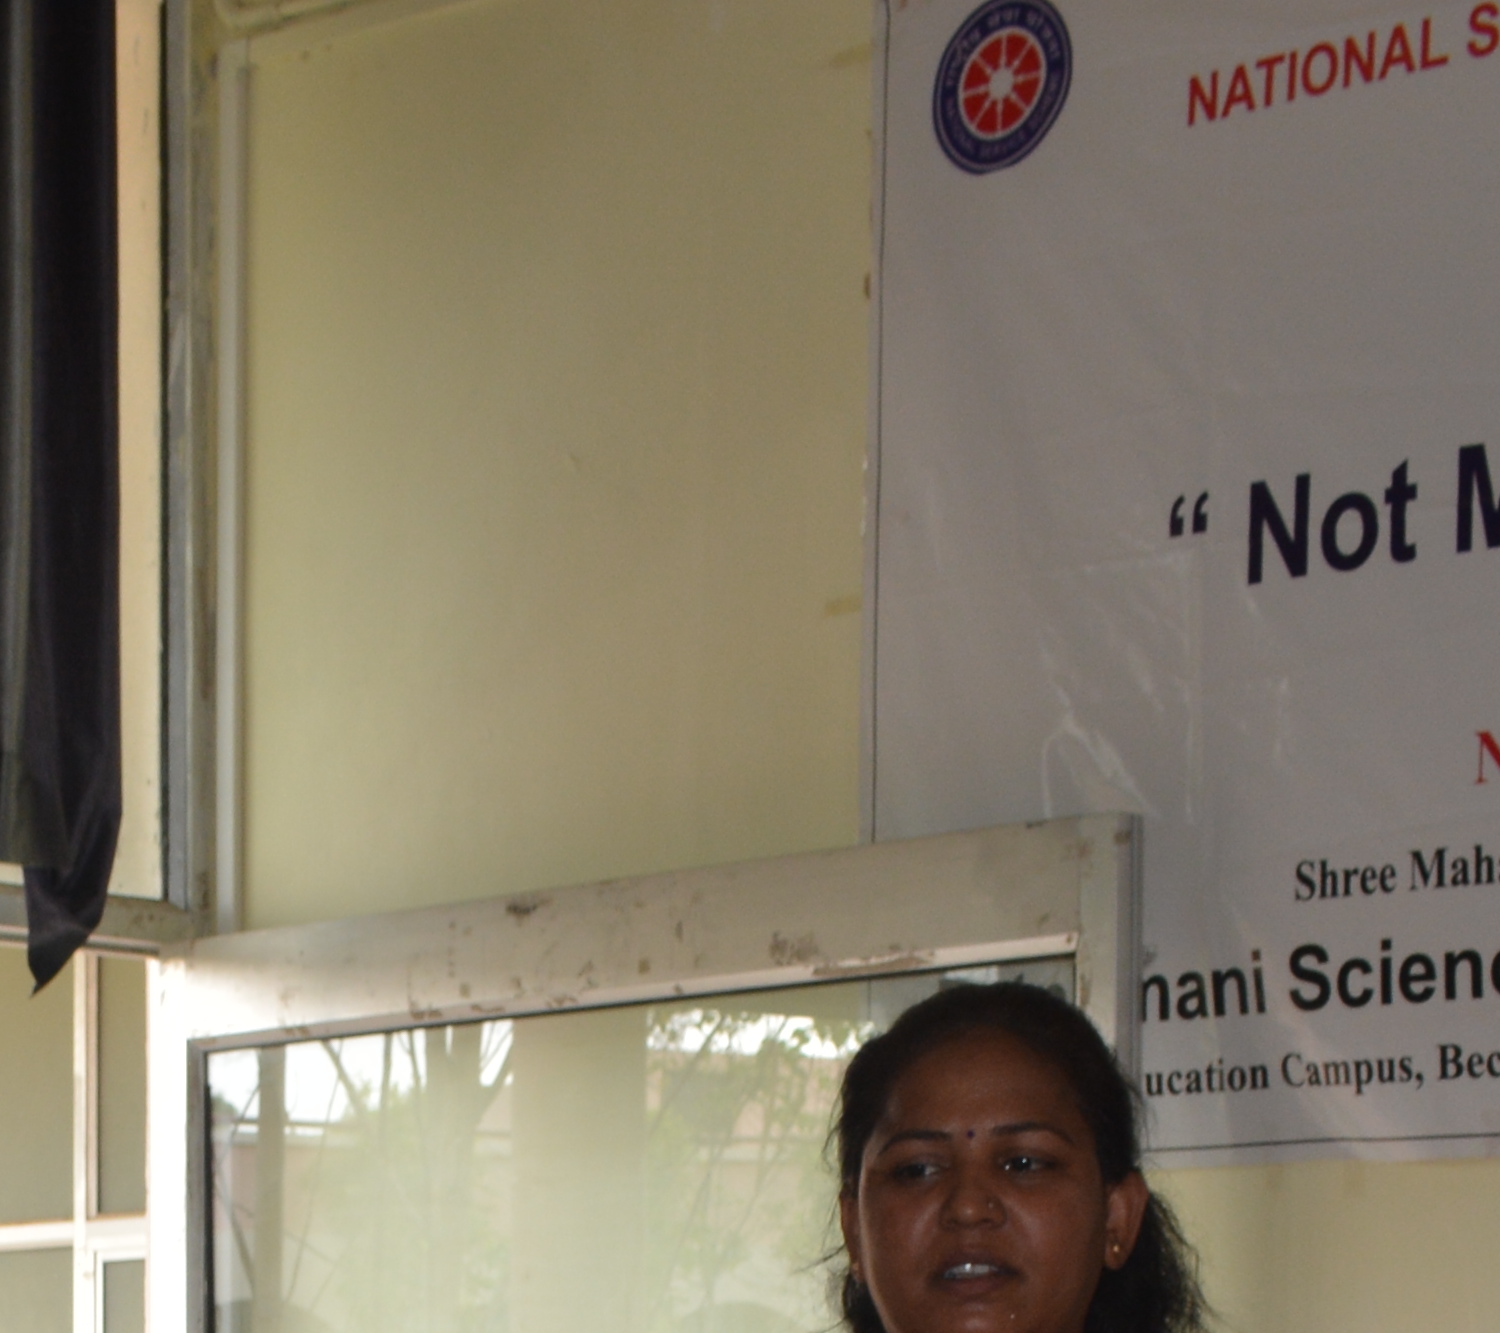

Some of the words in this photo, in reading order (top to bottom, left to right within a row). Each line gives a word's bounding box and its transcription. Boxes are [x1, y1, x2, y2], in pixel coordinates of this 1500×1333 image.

[1187, 17, 1450, 128] NATIONAL
[1247, 458, 1420, 587] Not
[1294, 859, 1398, 902] Shree
[1145, 1057, 1271, 1097] ucation
[1280, 1052, 1426, 1097] Campus,
